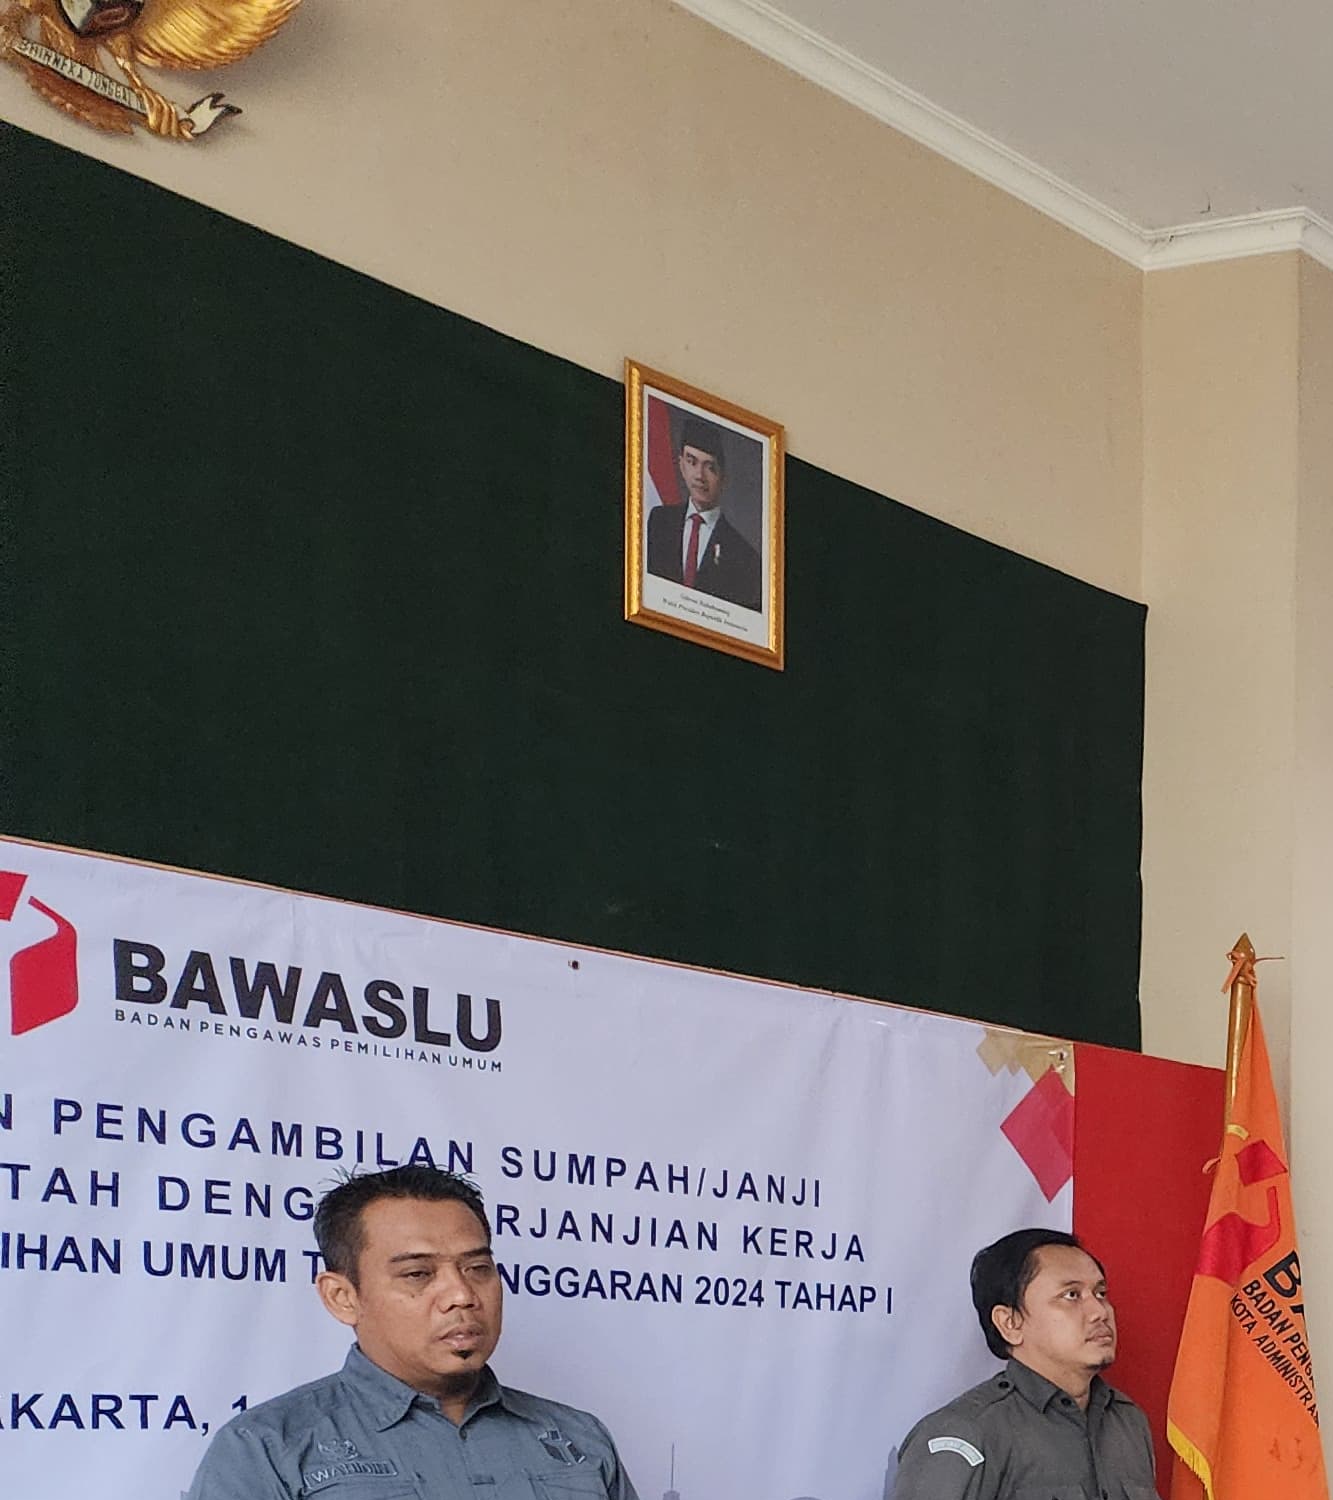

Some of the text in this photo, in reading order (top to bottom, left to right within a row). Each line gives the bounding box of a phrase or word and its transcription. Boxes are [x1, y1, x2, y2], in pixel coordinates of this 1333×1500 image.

[114, 938, 502, 1053] BAWASLU
[115, 1008, 502, 1073] BADAN PENGAWAS PEMILIHAN UMUM
[53, 1098, 473, 1174] PENGAMBILAN
[501, 1146, 820, 1208] SUMPAH/JANJI
[0, 1163, 865, 1263] TAH DENG RJANJIAN KERJA
[0, 1231, 121, 1275] IHAN
[143, 1240, 287, 1283] UMUM
[497, 1262, 683, 1304] NGGARAN
[694, 1276, 765, 1308] 2024
[775, 1280, 877, 1313] TAHAP
[886, 1286, 893, 1315] I
[1230, 1293, 1259, 1335] KOTA
[1243, 1279, 1315, 1382] BADAN PENG
[0, 1393, 210, 1436] KARTA,
